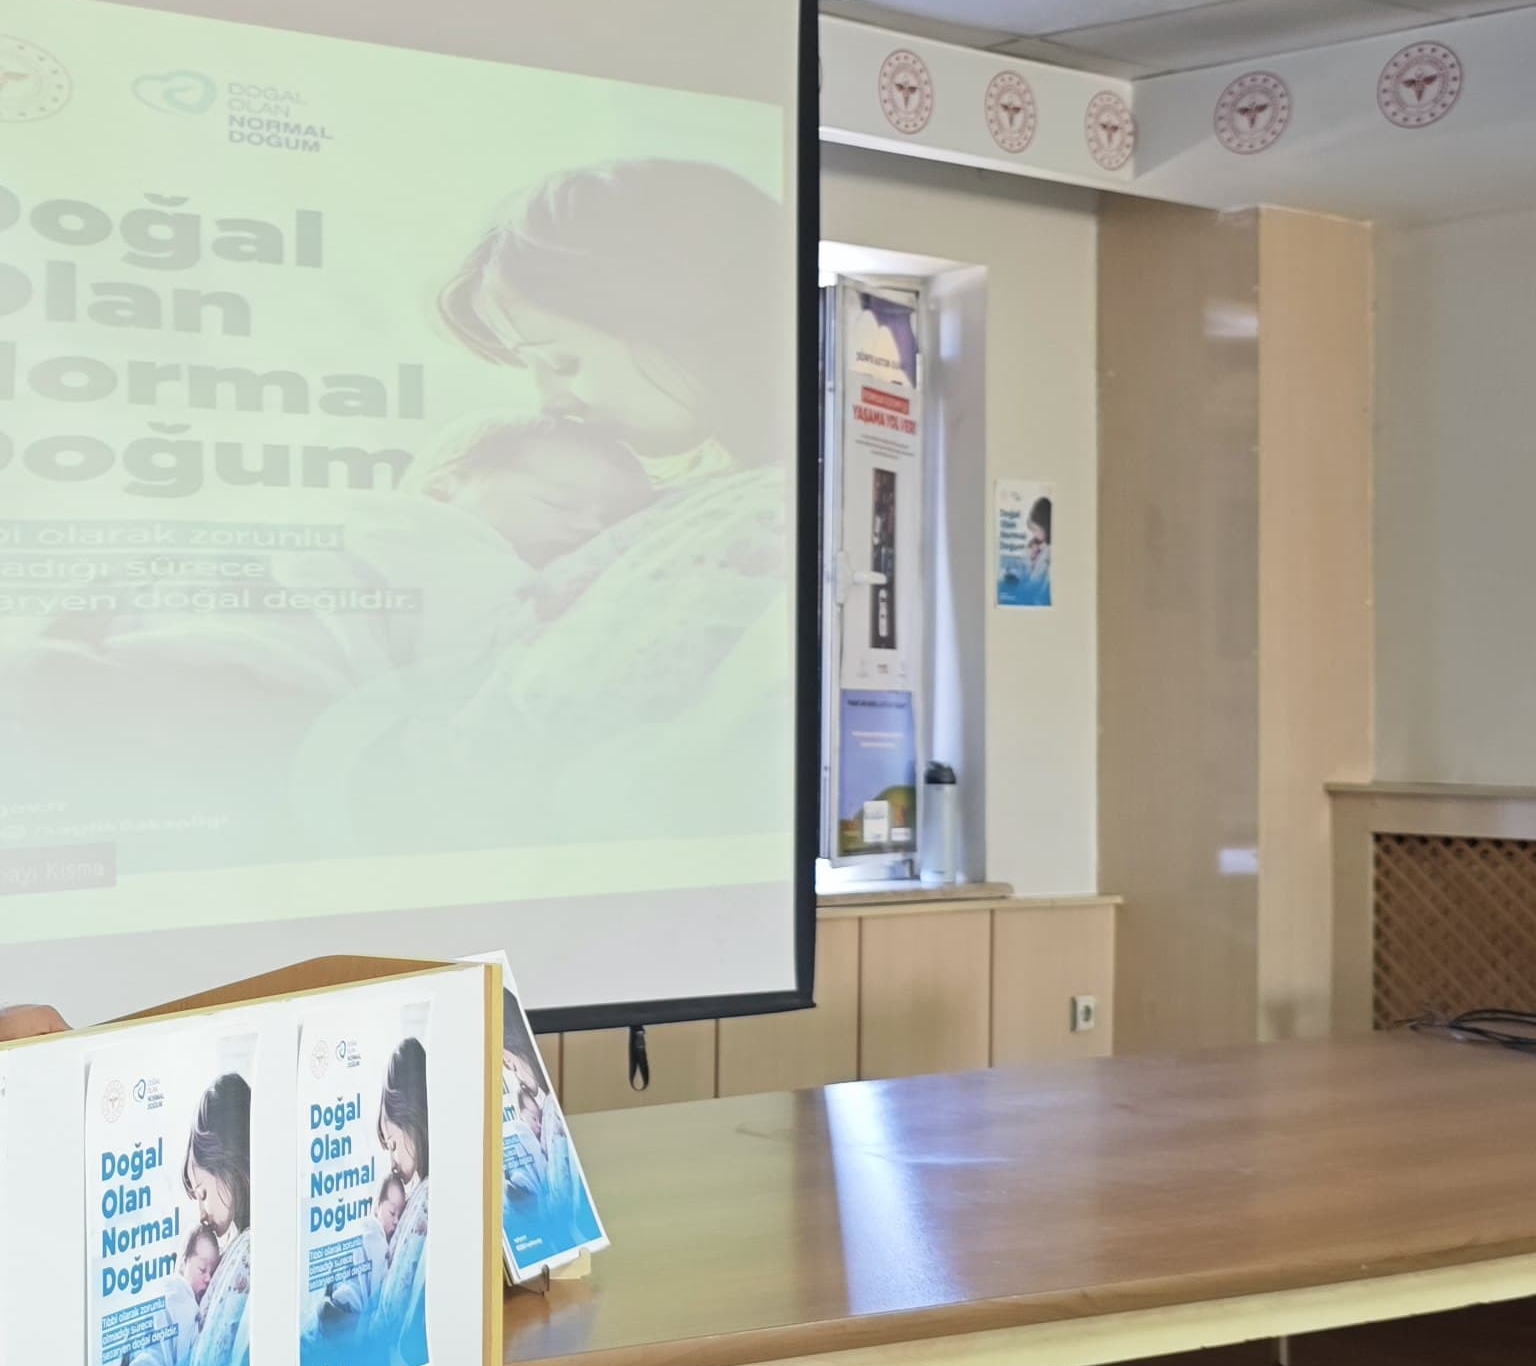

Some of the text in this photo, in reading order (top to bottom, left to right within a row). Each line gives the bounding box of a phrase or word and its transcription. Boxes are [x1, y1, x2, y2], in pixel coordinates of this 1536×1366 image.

[229, 115, 335, 139] NORMAL
[36, 522, 176, 546] olarak
[189, 525, 337, 548] zorunlu
[126, 556, 265, 579] sürece
[133, 586, 249, 613] doğal
[310, 1093, 361, 1130] Doğal
[102, 1137, 163, 1181] Doğal
[310, 1134, 352, 1163] Olan
[310, 1156, 375, 1198] Normal
[102, 1184, 151, 1219] Olan
[310, 1196, 373, 1233] Doğum
[102, 1207, 180, 1258] Normal
[102, 1251, 177, 1297] Doğum
